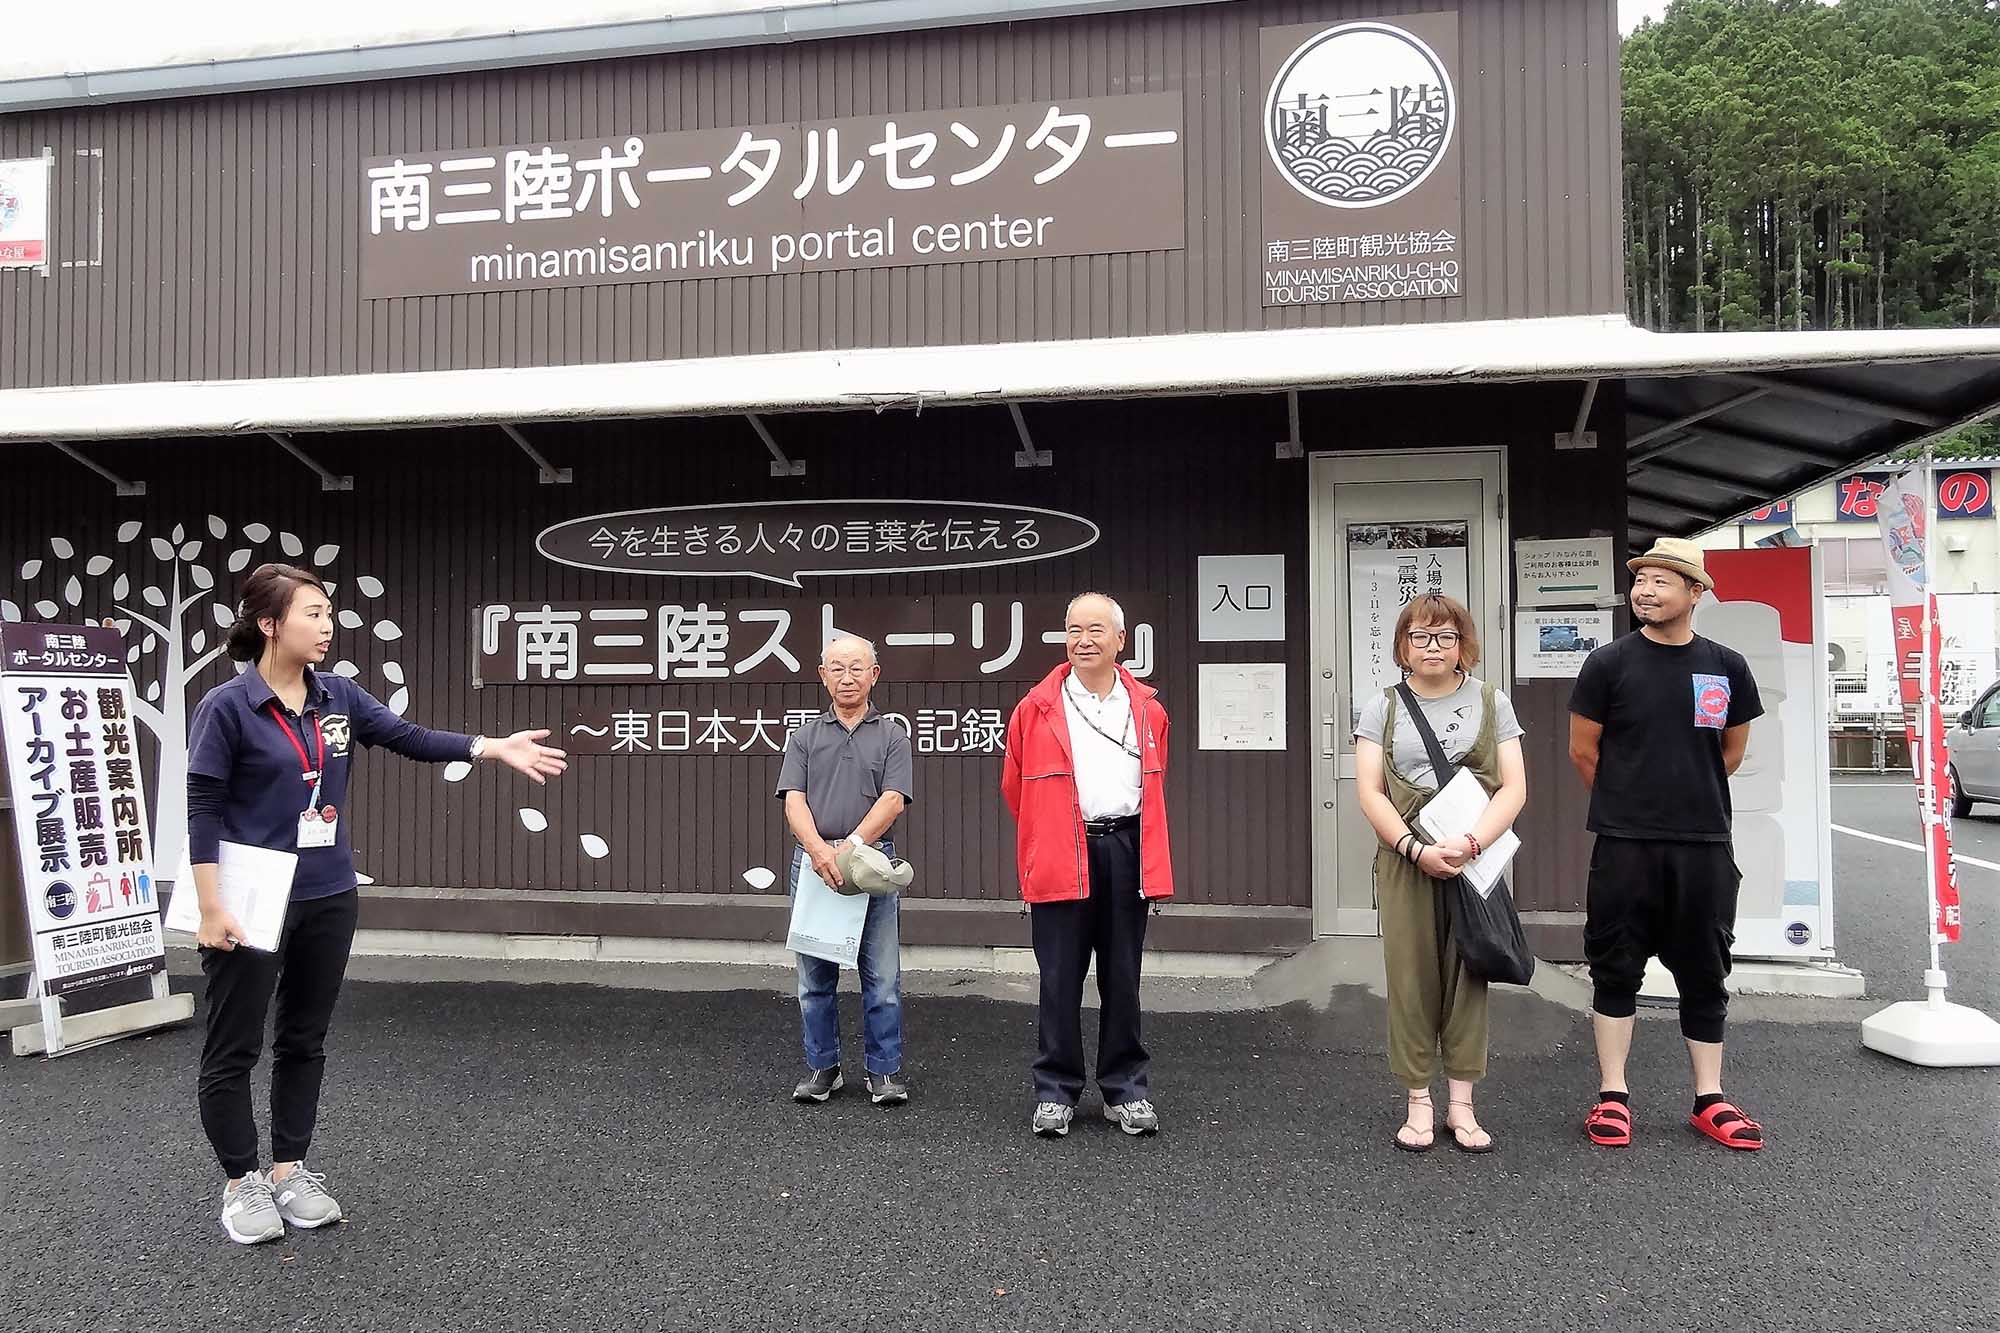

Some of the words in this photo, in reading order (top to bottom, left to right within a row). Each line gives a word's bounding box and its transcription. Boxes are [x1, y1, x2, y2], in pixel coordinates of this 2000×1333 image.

[1276, 83, 1446, 149] 南三陸
[367, 105, 1178, 235] 南三陸ポータルセンター
[470, 229, 754, 283] minamisanriku
[771, 217, 895, 272] portal
[911, 213, 1054, 254] center
[1266, 229, 1457, 264] 南三陸町観光協会
[1265, 260, 1459, 288] MINAMISANRIKU-CHO
[1266, 283, 1338, 304] TOURIST
[1342, 277, 1459, 301] ASSOCIATION
[588, 518, 1041, 560] 今を生きる人々の言葉を伝える
[1211, 584, 1271, 611] 入口
[13, 650, 119, 667] ポータルセンター
[45, 634, 87, 649] 南三陸
[18, 687, 71, 872] アーカイブ展示
[60, 687, 108, 868] お土産販売
[97, 687, 143, 863] 観光案内所
[52, 918, 153, 951] 南三陸町観光協会
[55, 935, 155, 963] MINAMISANRIKU-CHO
[100, 945, 157, 967] ASSOCIATION
